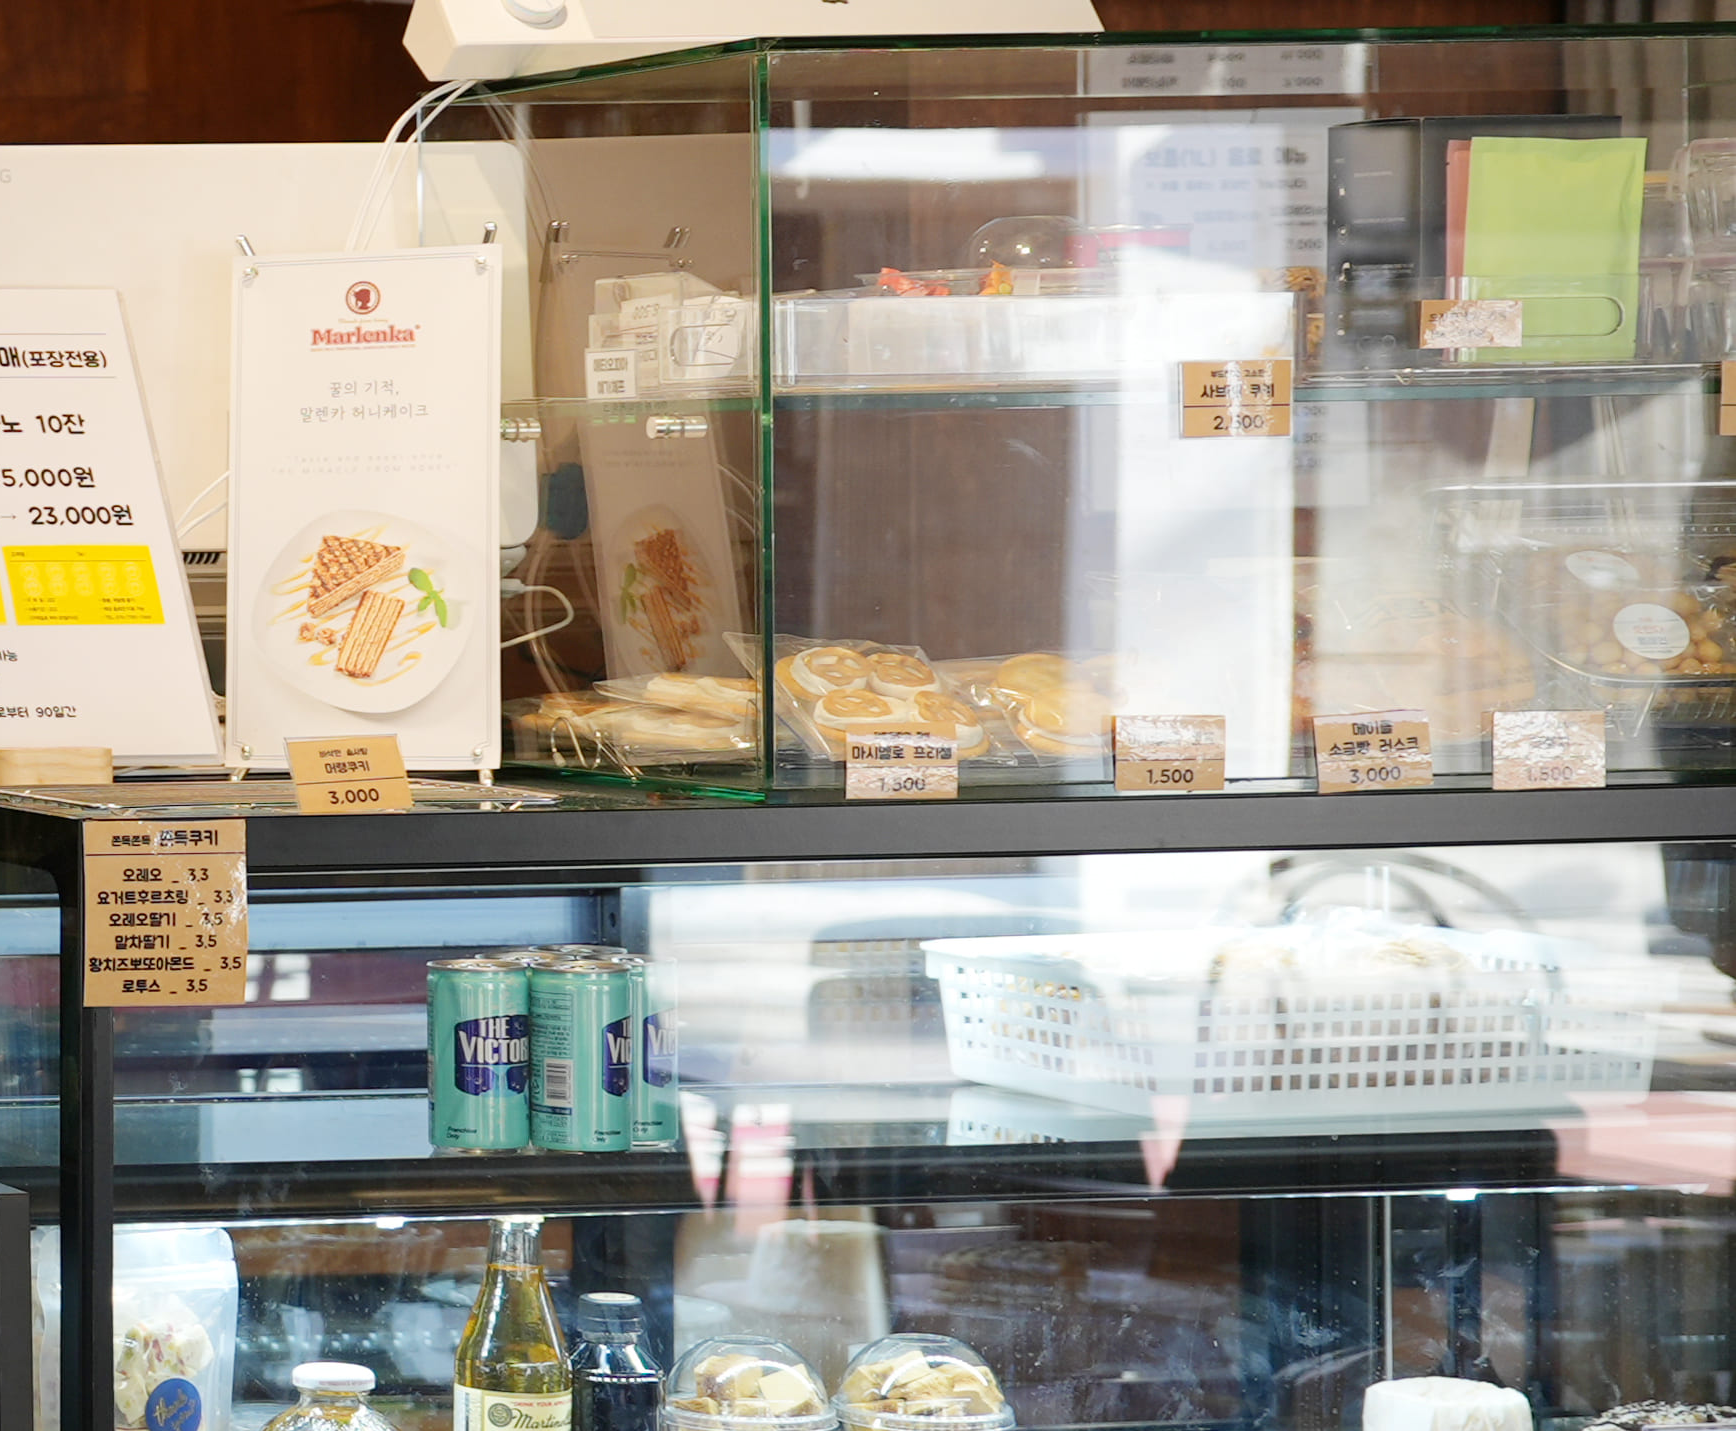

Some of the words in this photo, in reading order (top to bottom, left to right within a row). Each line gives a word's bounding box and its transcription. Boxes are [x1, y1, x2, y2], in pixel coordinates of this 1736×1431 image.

[311, 324, 415, 347] Marlenka
[36, 414, 85, 435] 10잔
[28, 505, 133, 527] 23,000원
[325, 761, 370, 774] 머랭쿠키
[1349, 766, 1402, 784] 3,000
[1147, 768, 1194, 785] 1,500
[328, 788, 379, 804] 3,000
[123, 868, 162, 882] 오레오
[115, 935, 170, 950] 말차딸기
[196, 935, 217, 948] 3.5
[122, 980, 161, 993] 로투스
[186, 979, 208, 992] 3.5
[479, 1017, 509, 1038] THE
